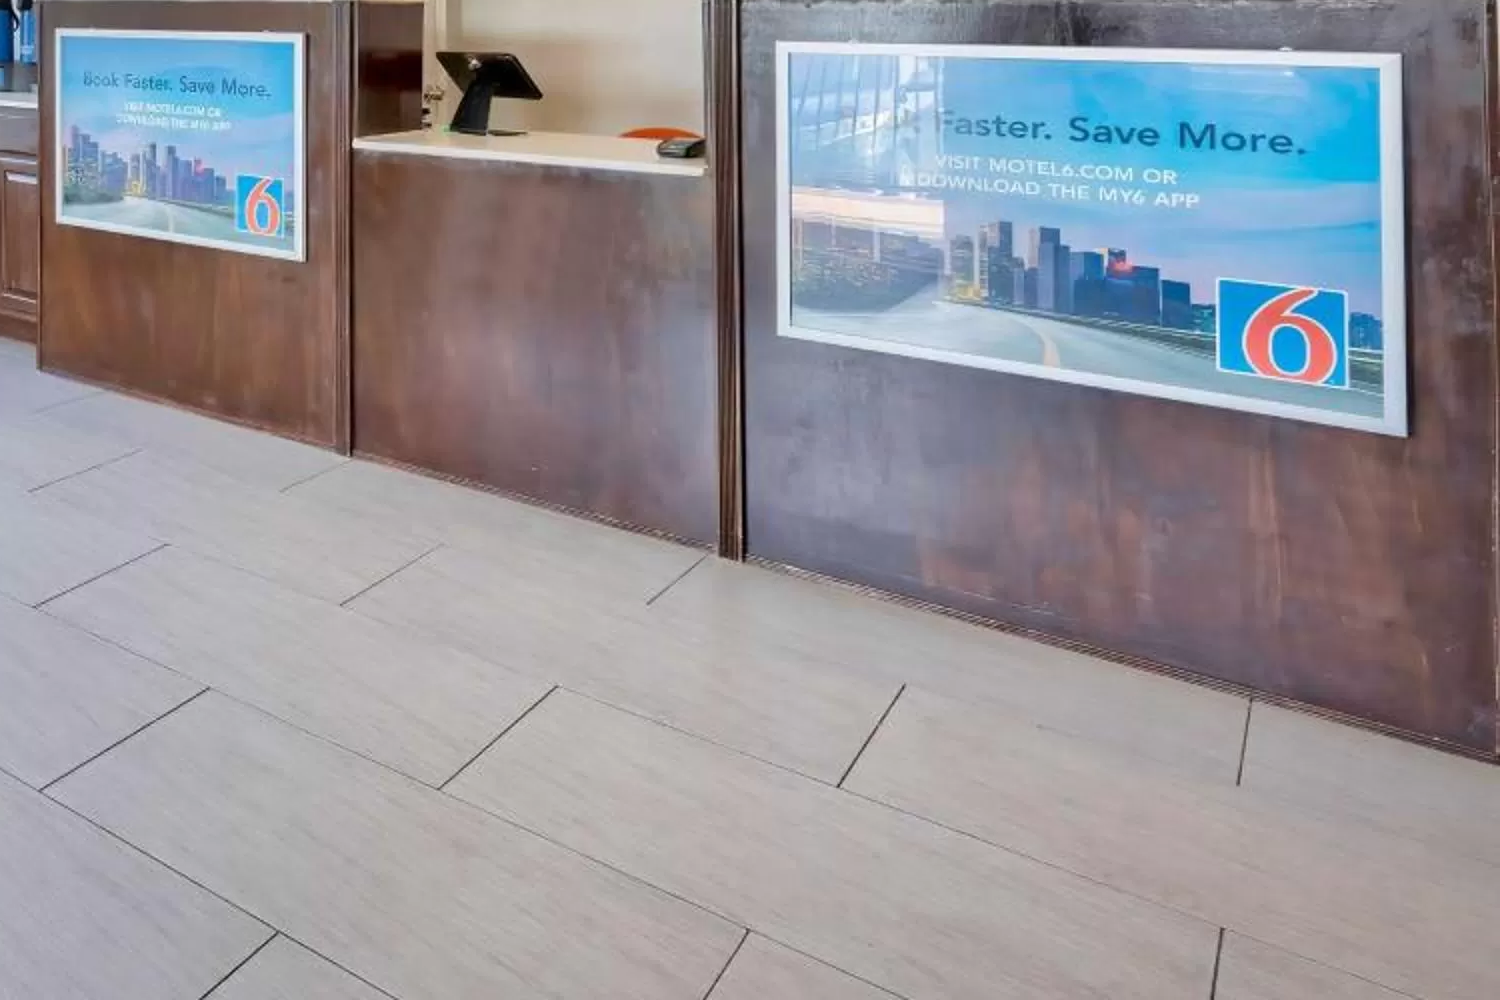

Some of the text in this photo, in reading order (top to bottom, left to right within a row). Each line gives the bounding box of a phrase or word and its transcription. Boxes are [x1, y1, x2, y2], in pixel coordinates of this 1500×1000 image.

[83, 71, 271, 98] Book Faster. Save More.
[936, 108, 1053, 141] Faster.
[1068, 115, 1161, 148] Save
[1178, 120, 1307, 156] More.
[918, 171, 1201, 209] DOWNLOAD THE MY6 APP
[936, 155, 1179, 185] VISIT MOTEL6.COM OR
[244, 175, 281, 236] 6
[1241, 286, 1338, 385] 6
